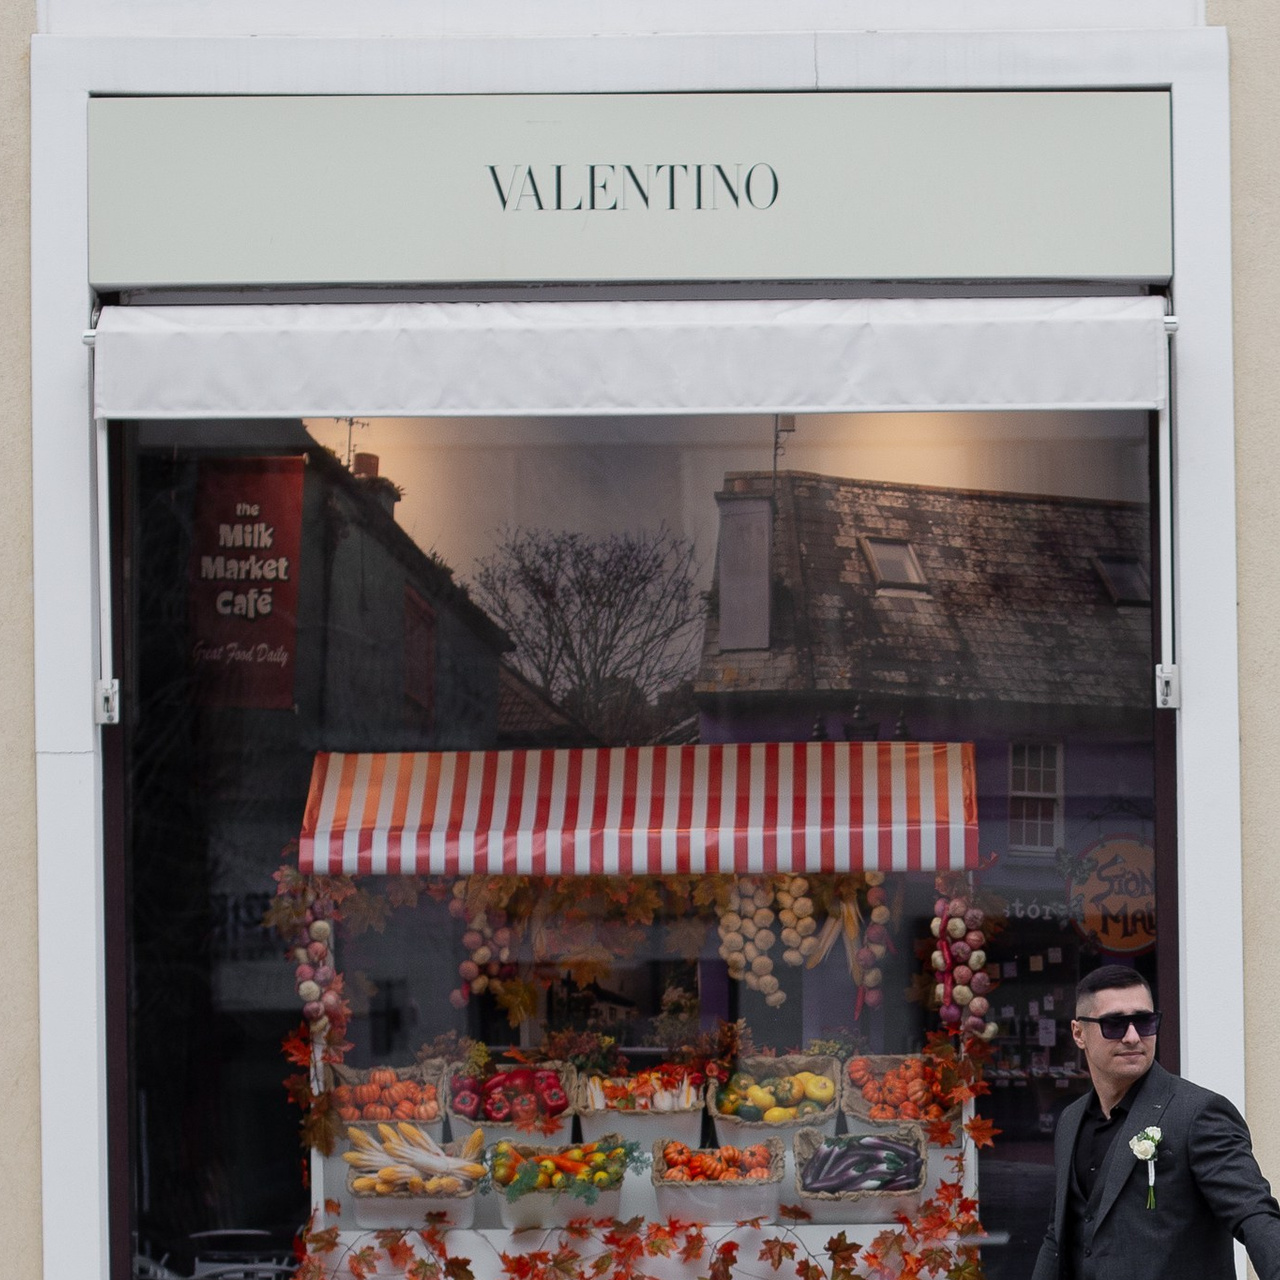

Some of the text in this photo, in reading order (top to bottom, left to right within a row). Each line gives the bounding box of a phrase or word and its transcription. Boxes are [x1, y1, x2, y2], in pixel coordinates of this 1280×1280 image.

[484, 162, 780, 212] VALENTINO
[235, 502, 261, 517] the
[218, 522, 274, 549] Milk
[200, 554, 290, 581] Market
[215, 587, 273, 619] Café
[225, 641, 255, 667] Food
[256, 642, 290, 668] Daily
